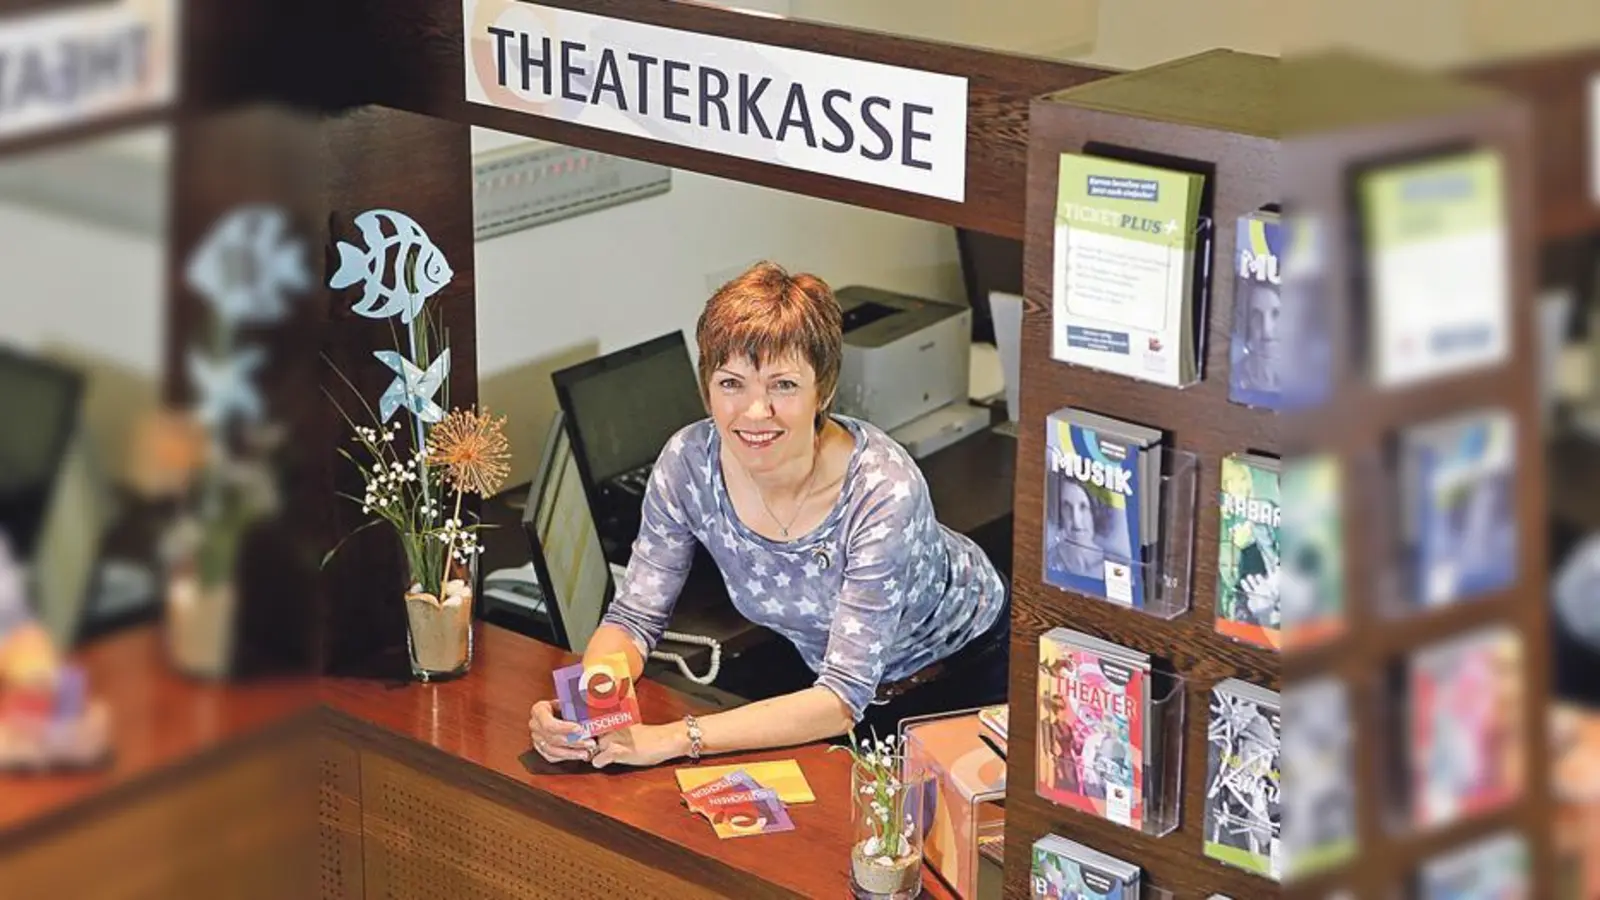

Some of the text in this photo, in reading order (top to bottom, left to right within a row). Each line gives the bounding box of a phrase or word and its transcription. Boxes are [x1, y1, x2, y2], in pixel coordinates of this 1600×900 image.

[487, 27, 933, 170] THEATERKASSE
[1051, 449, 1133, 496] MUSIK
[1055, 674, 1136, 717] THEATER
